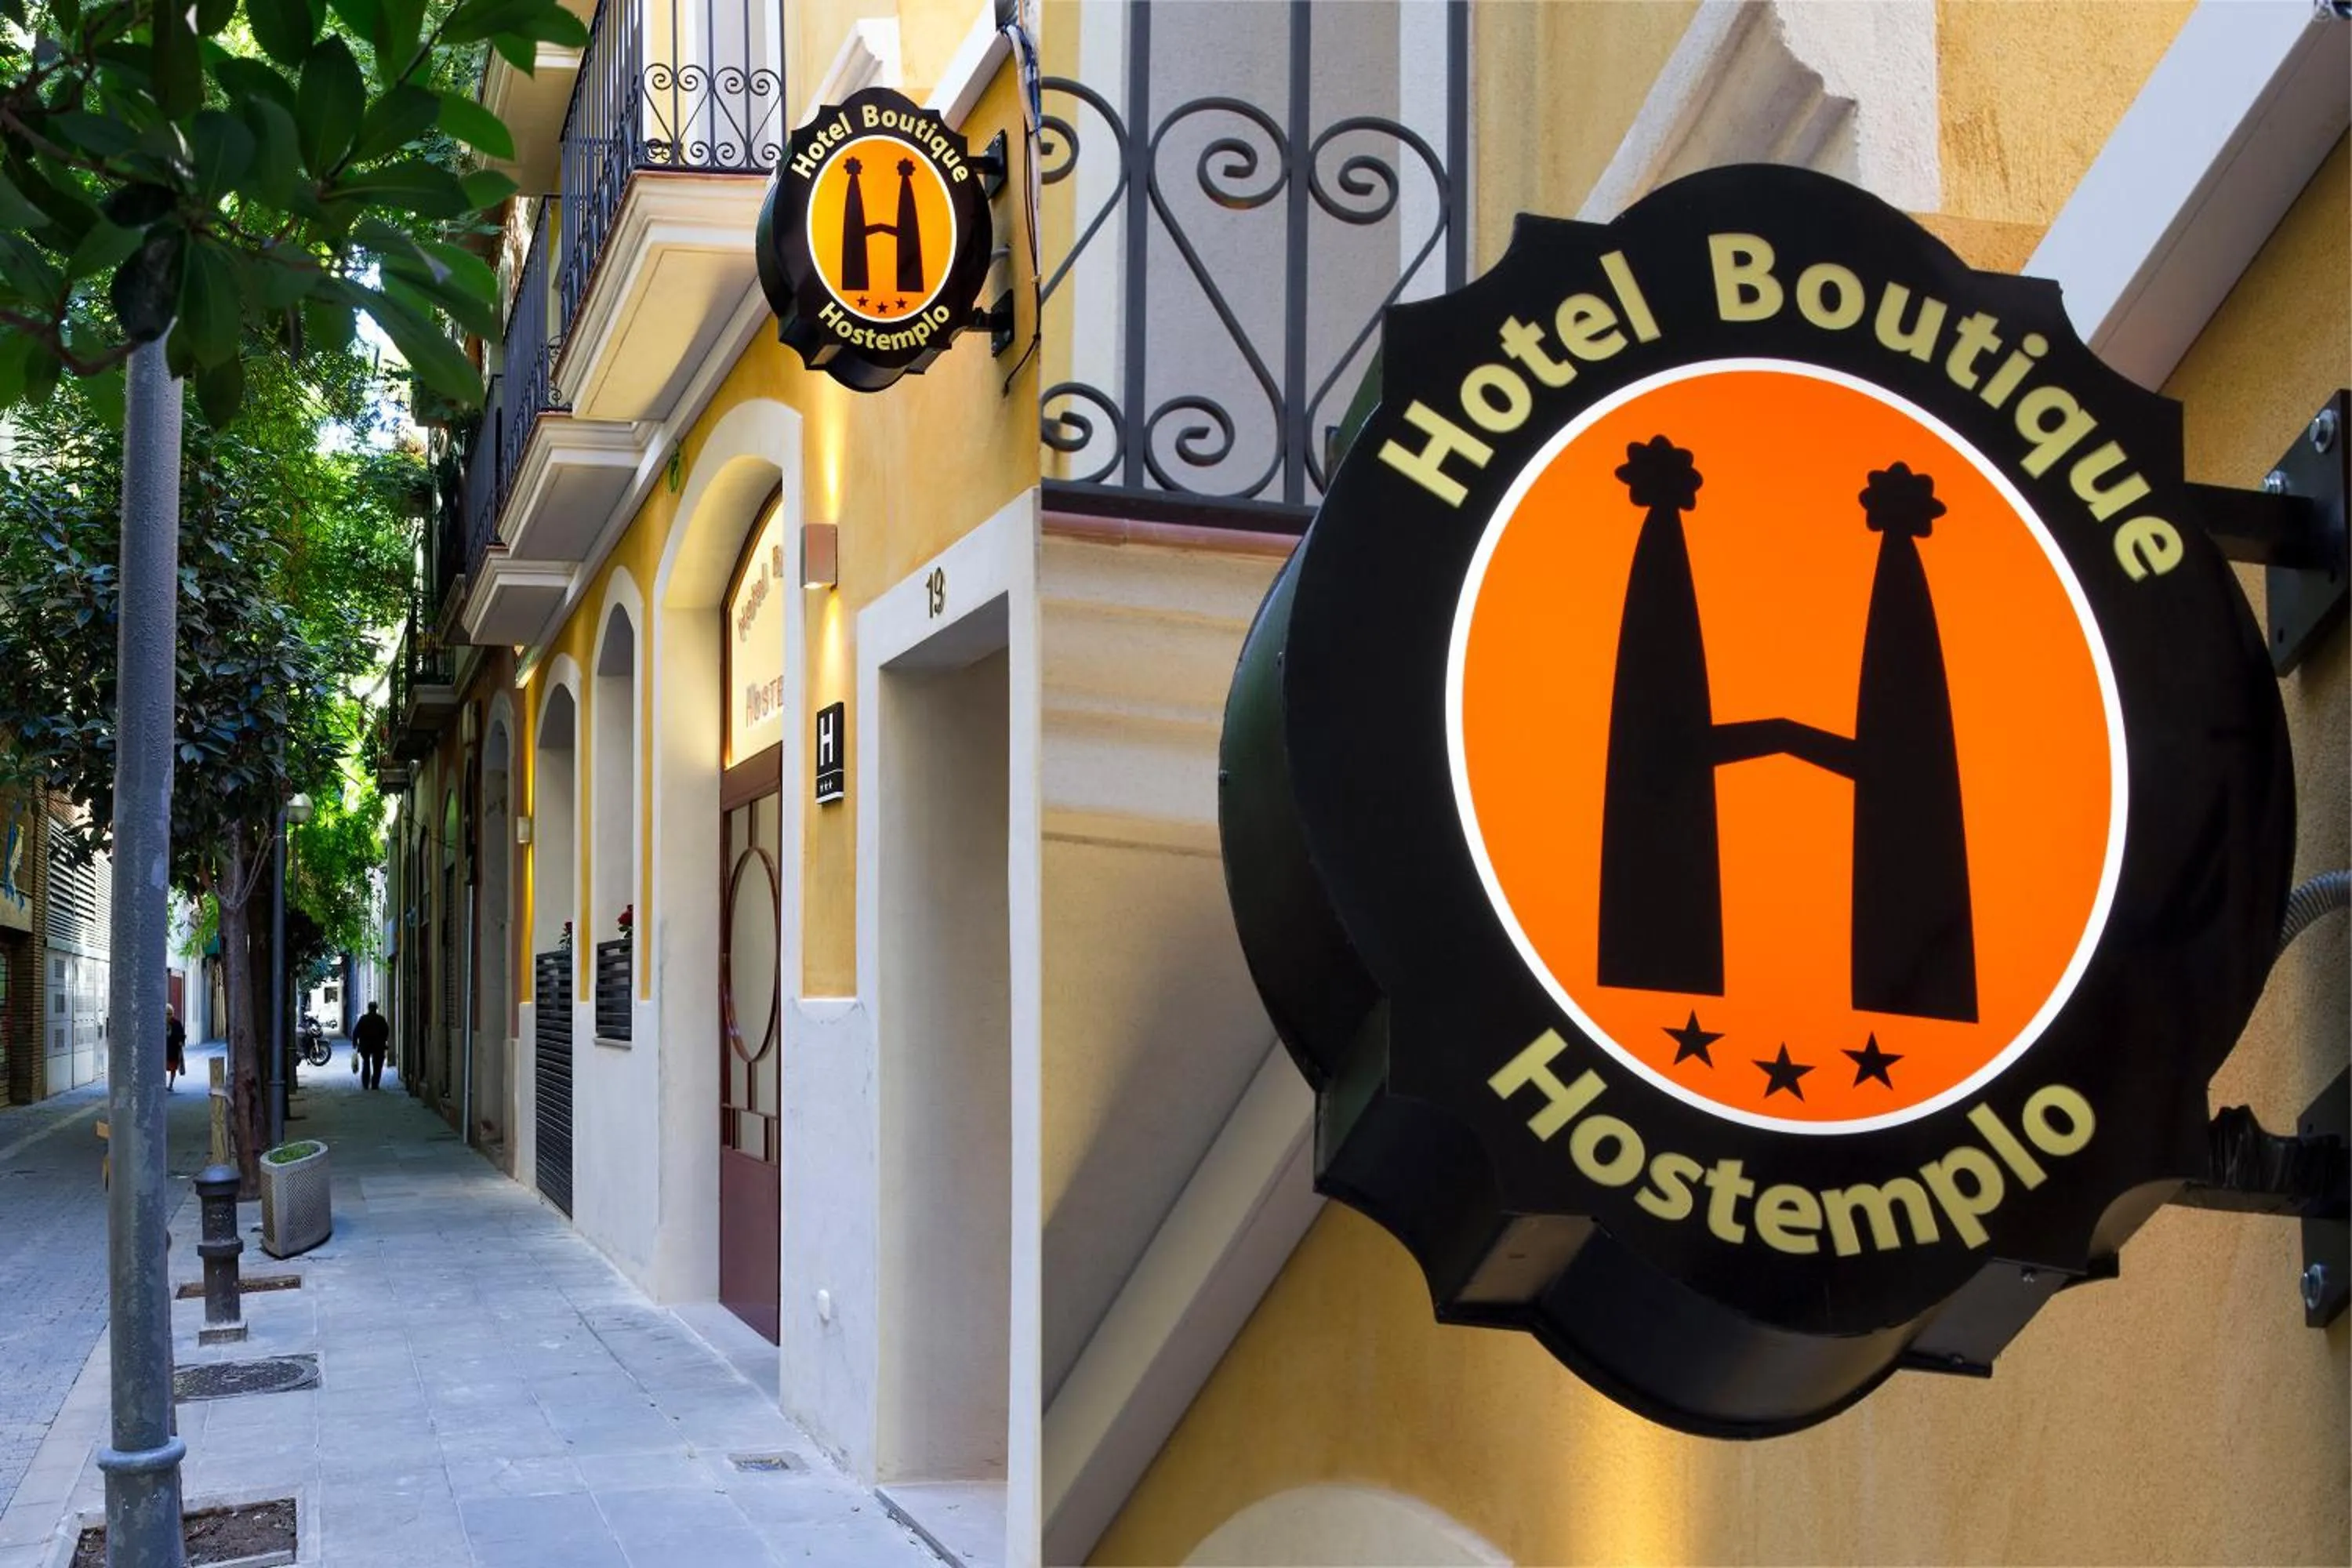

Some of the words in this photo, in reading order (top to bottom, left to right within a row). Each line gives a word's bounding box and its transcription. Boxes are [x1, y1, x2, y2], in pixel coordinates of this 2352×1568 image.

[792, 112, 853, 179] Hotel
[862, 104, 968, 183] Boutique
[818, 302, 949, 350] Hostemplo
[1378, 249, 1661, 508] Hotel
[1708, 233, 2185, 580] Boutique
[926, 566, 946, 619] 19
[820, 713, 833, 766] H
[1487, 1028, 2096, 1257] Hostemplo
